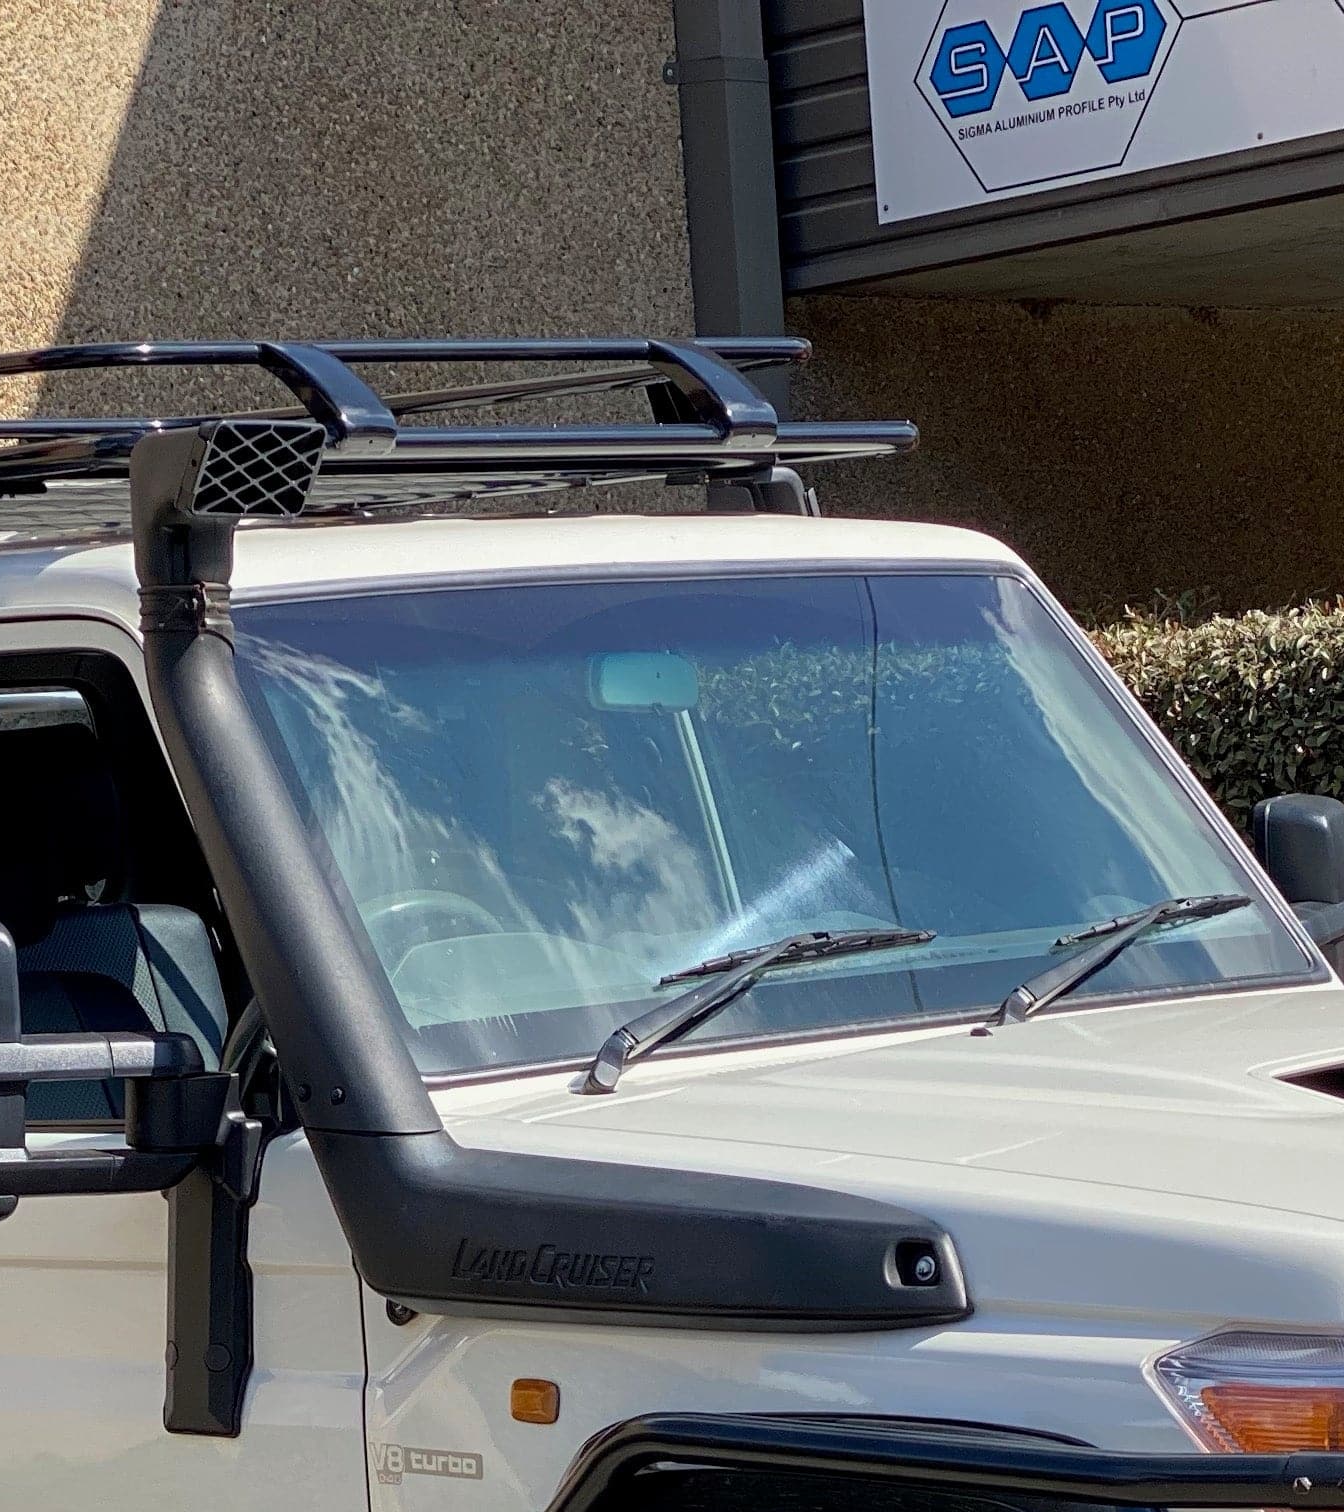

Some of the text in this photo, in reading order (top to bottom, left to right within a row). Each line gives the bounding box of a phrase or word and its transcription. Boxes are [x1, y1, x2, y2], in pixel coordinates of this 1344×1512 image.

[939, 4, 1144, 99] SAP
[957, 89, 1146, 141] SIGMA ALUMINIUM PROFILE Pty Ltd
[368, 1442, 476, 1475] V8 turbo
